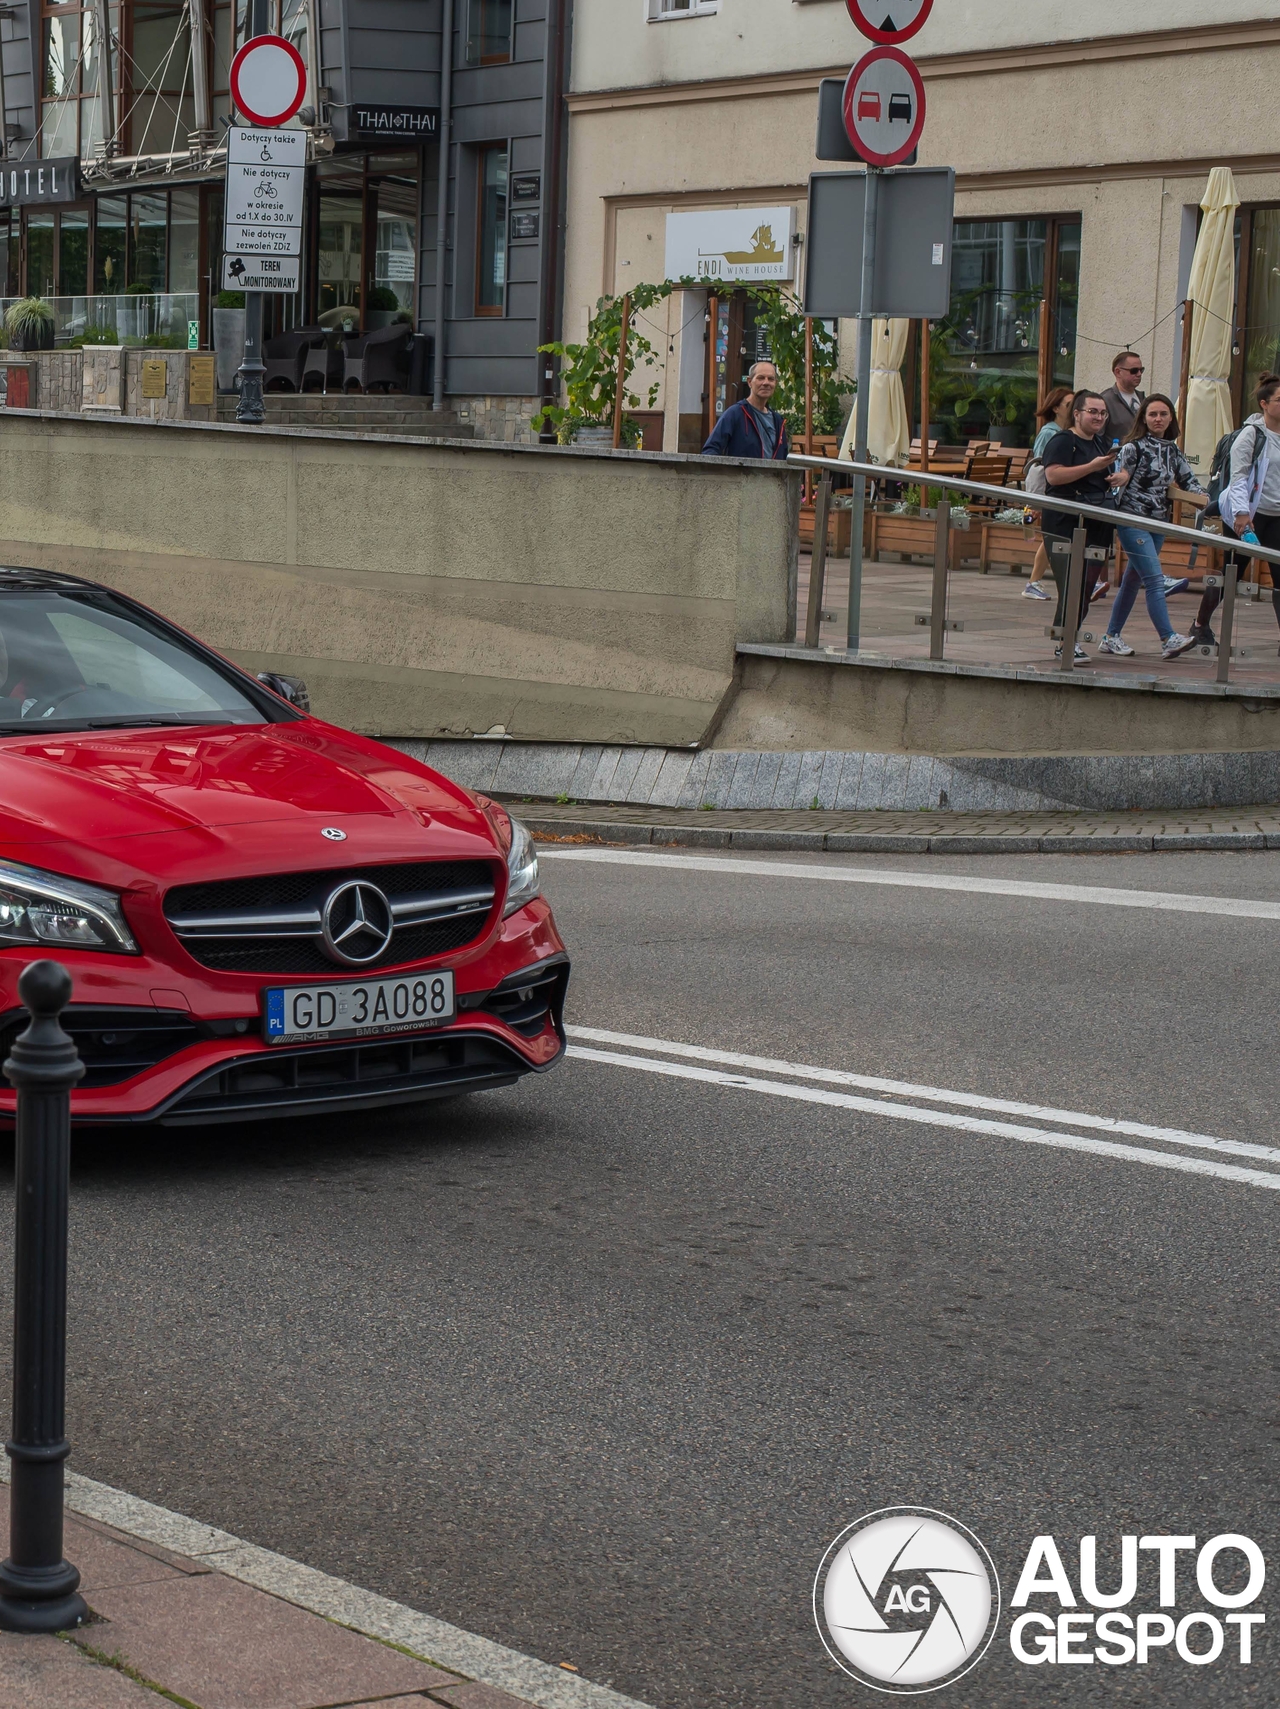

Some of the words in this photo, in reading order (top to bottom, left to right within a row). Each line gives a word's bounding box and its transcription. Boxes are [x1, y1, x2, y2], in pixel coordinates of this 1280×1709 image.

[357, 111, 393, 128] THAI
[400, 113, 436, 130] THAI
[241, 132, 272, 144] Dotyczy
[274, 135, 296, 144] także
[243, 168, 257, 177] Nie
[260, 169, 291, 180] dotyczy
[255, 201, 284, 210] okresie
[236, 212, 247, 220] od
[248, 212, 260, 220] 1.X
[261, 213, 272, 221] do
[274, 213, 294, 222] 30.IV
[241, 229, 256, 237] Nie
[257, 230, 287, 241] dotyczy
[236, 242, 272, 250] zezwoleń
[273, 242, 291, 251] ZDiZ
[260, 260, 281, 272] TEREN
[697, 260, 721, 276] ENDI
[726, 266, 750, 275] WINE
[754, 265, 784, 274] HOUSE
[244, 276, 296, 289] MONITOROWANY
[292, 991, 337, 1029] GD
[351, 977, 446, 1024] 3A088
[270, 1018, 283, 1029] PL
[356, 1026, 379, 1037] BMG
[383, 1019, 438, 1033] Goworowski
